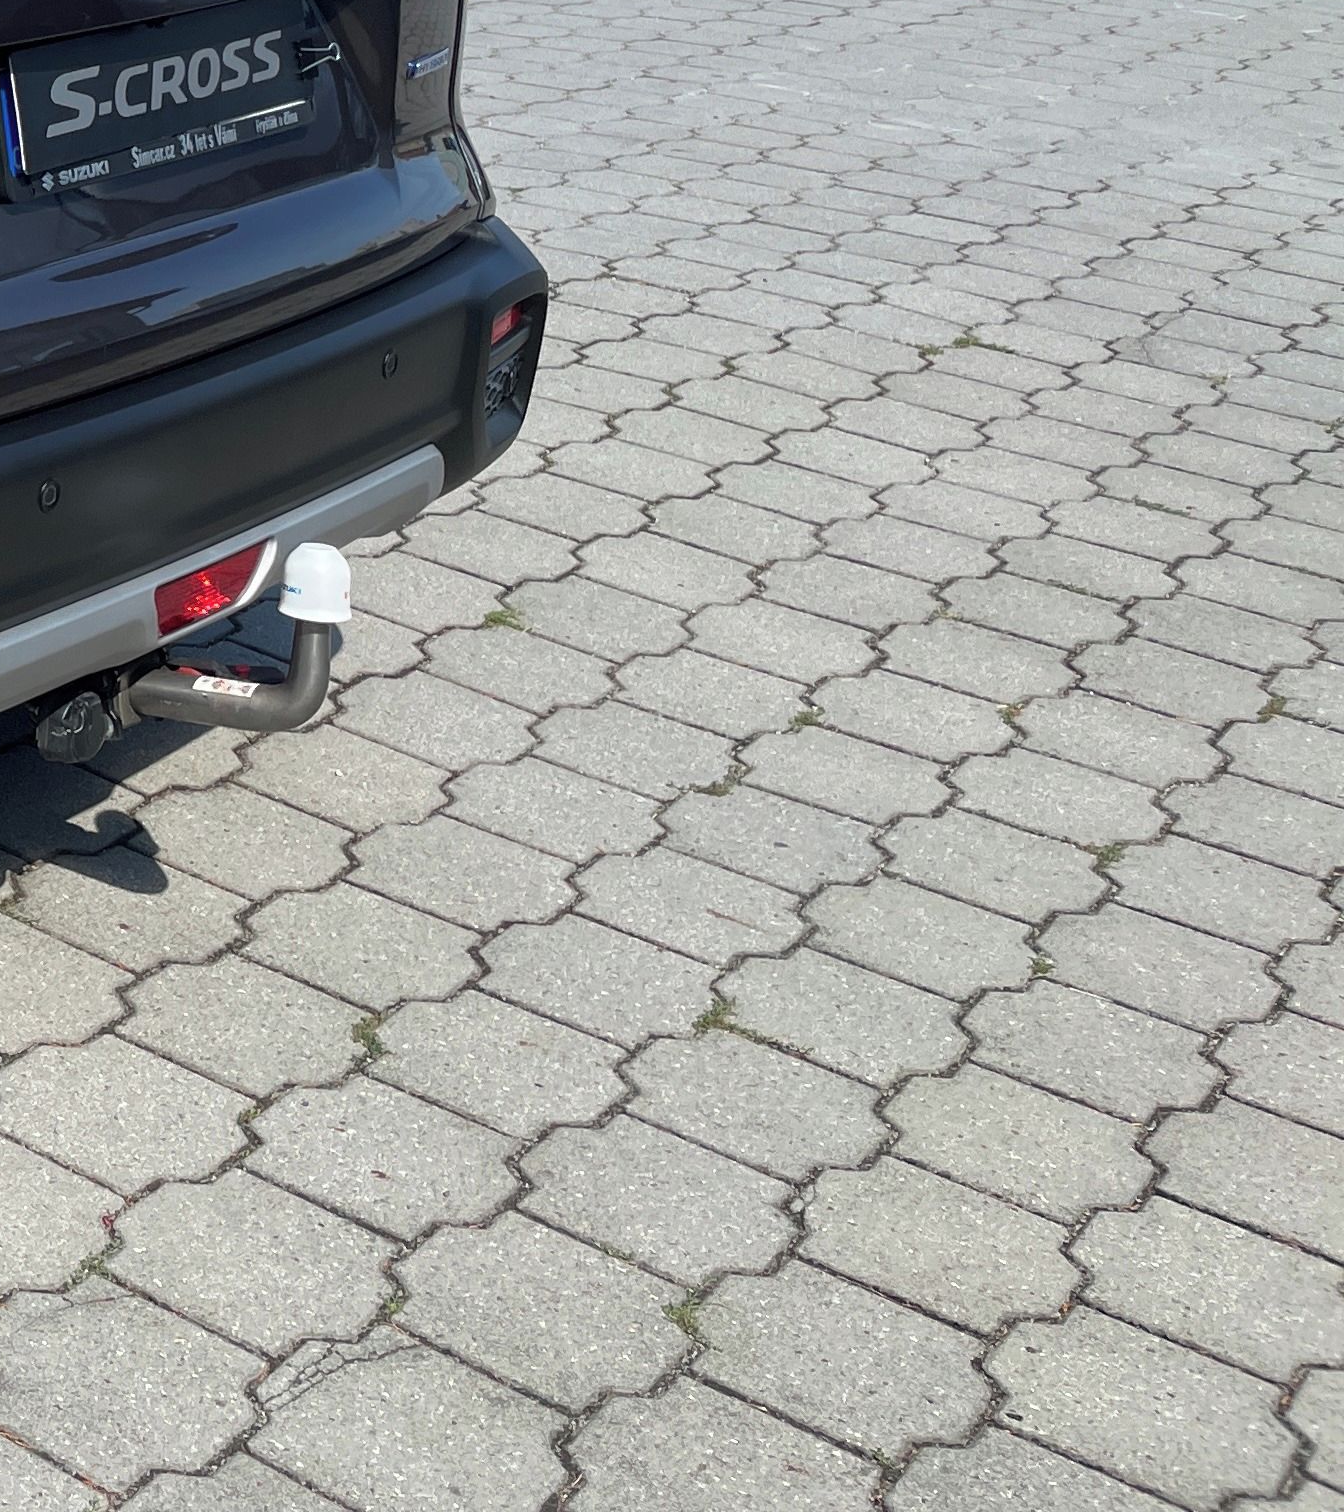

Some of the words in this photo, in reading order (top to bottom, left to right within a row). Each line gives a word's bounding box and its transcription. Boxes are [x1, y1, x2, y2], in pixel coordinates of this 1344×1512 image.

[131, 143, 176, 169] Simcar.cz
[178, 133, 194, 157] 34
[194, 133, 208, 152] let
[213, 123, 238, 146] Vámi
[58, 160, 110, 187] SUZUKI
